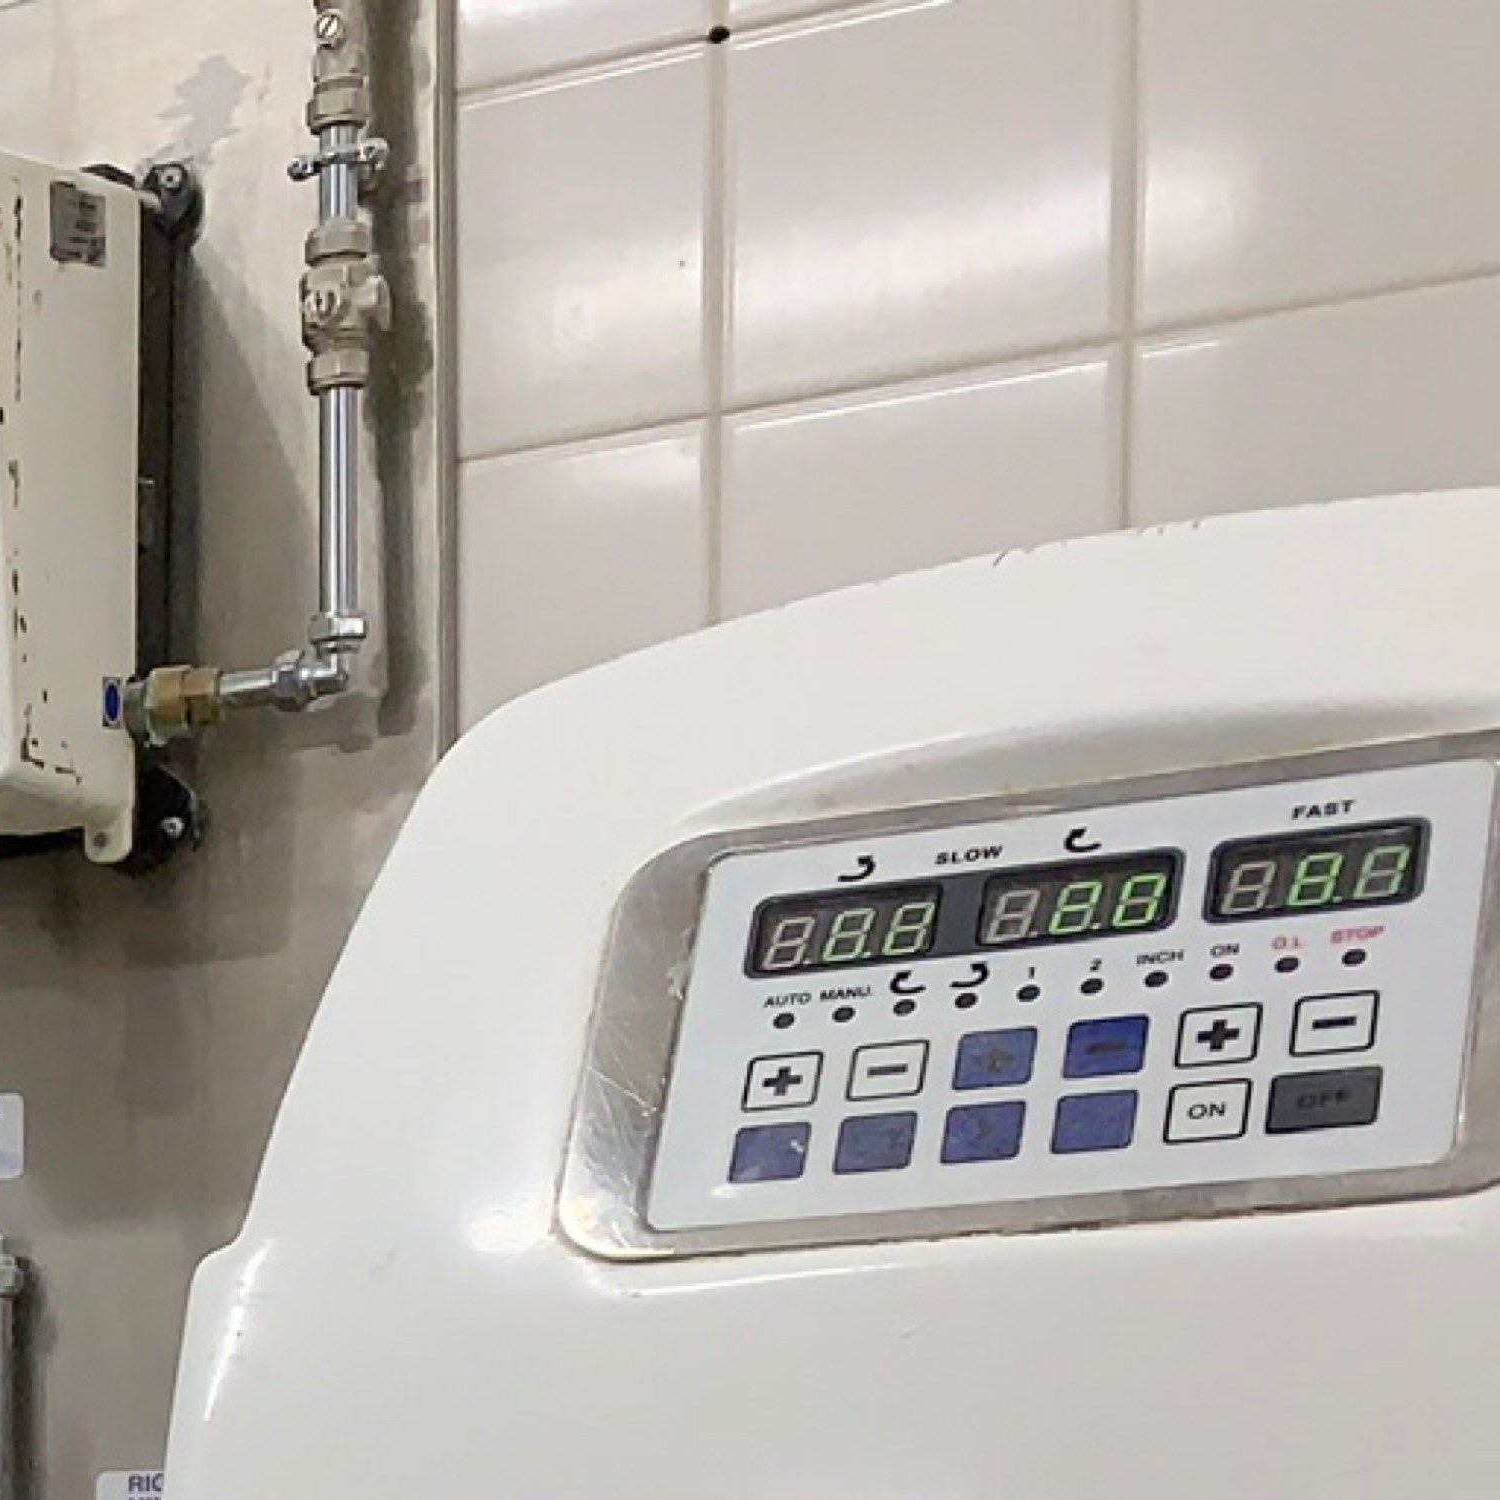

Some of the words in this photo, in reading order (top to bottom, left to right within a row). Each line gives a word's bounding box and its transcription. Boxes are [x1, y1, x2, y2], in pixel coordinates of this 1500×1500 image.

[1291, 799, 1355, 820] FAST
[934, 845, 1003, 865] SLOW
[763, 992, 813, 1008] AUTO
[1136, 949, 1185, 966] INCH
[1209, 944, 1241, 958] ON
[1329, 925, 1387, 945] STOP
[1297, 1090, 1349, 1109] OFF
[1186, 1102, 1226, 1120] ON
